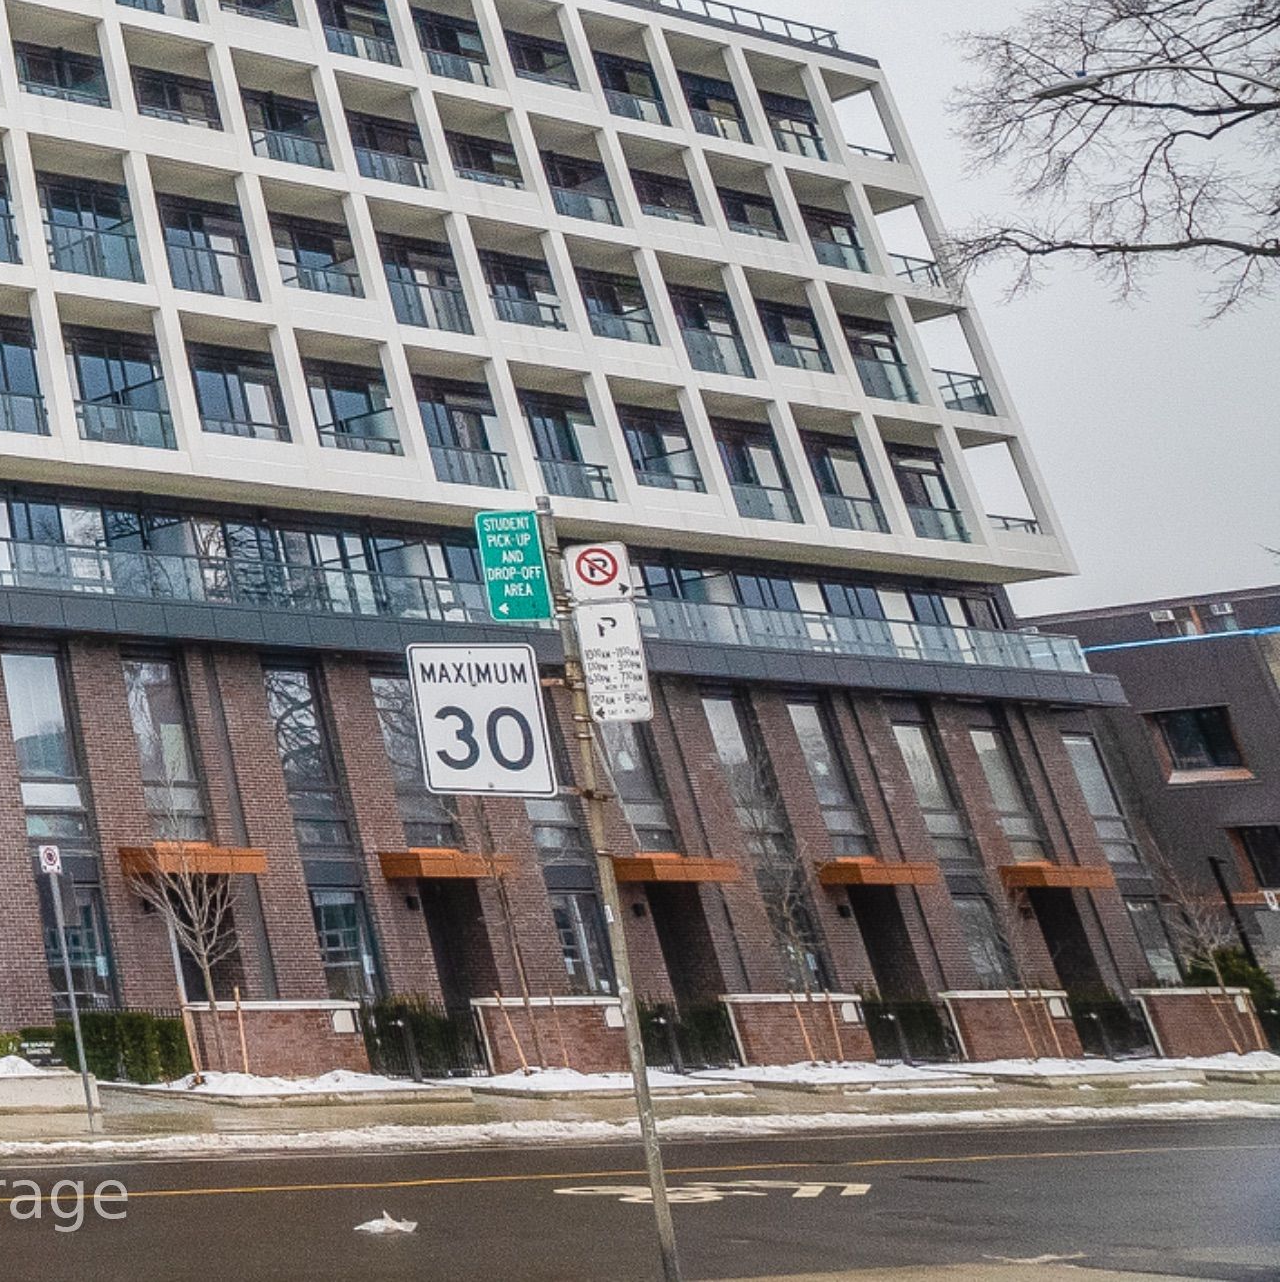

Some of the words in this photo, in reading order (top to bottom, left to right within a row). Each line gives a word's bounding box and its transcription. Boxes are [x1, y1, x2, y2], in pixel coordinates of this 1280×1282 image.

[483, 516, 530, 532] STUDENT
[486, 533, 531, 548] PICK-UP
[502, 549, 524, 564] AND
[486, 566, 542, 581] DROP-OFF
[503, 582, 534, 597] AREA
[419, 662, 528, 685] MAXIMUM
[434, 705, 535, 772] 30
